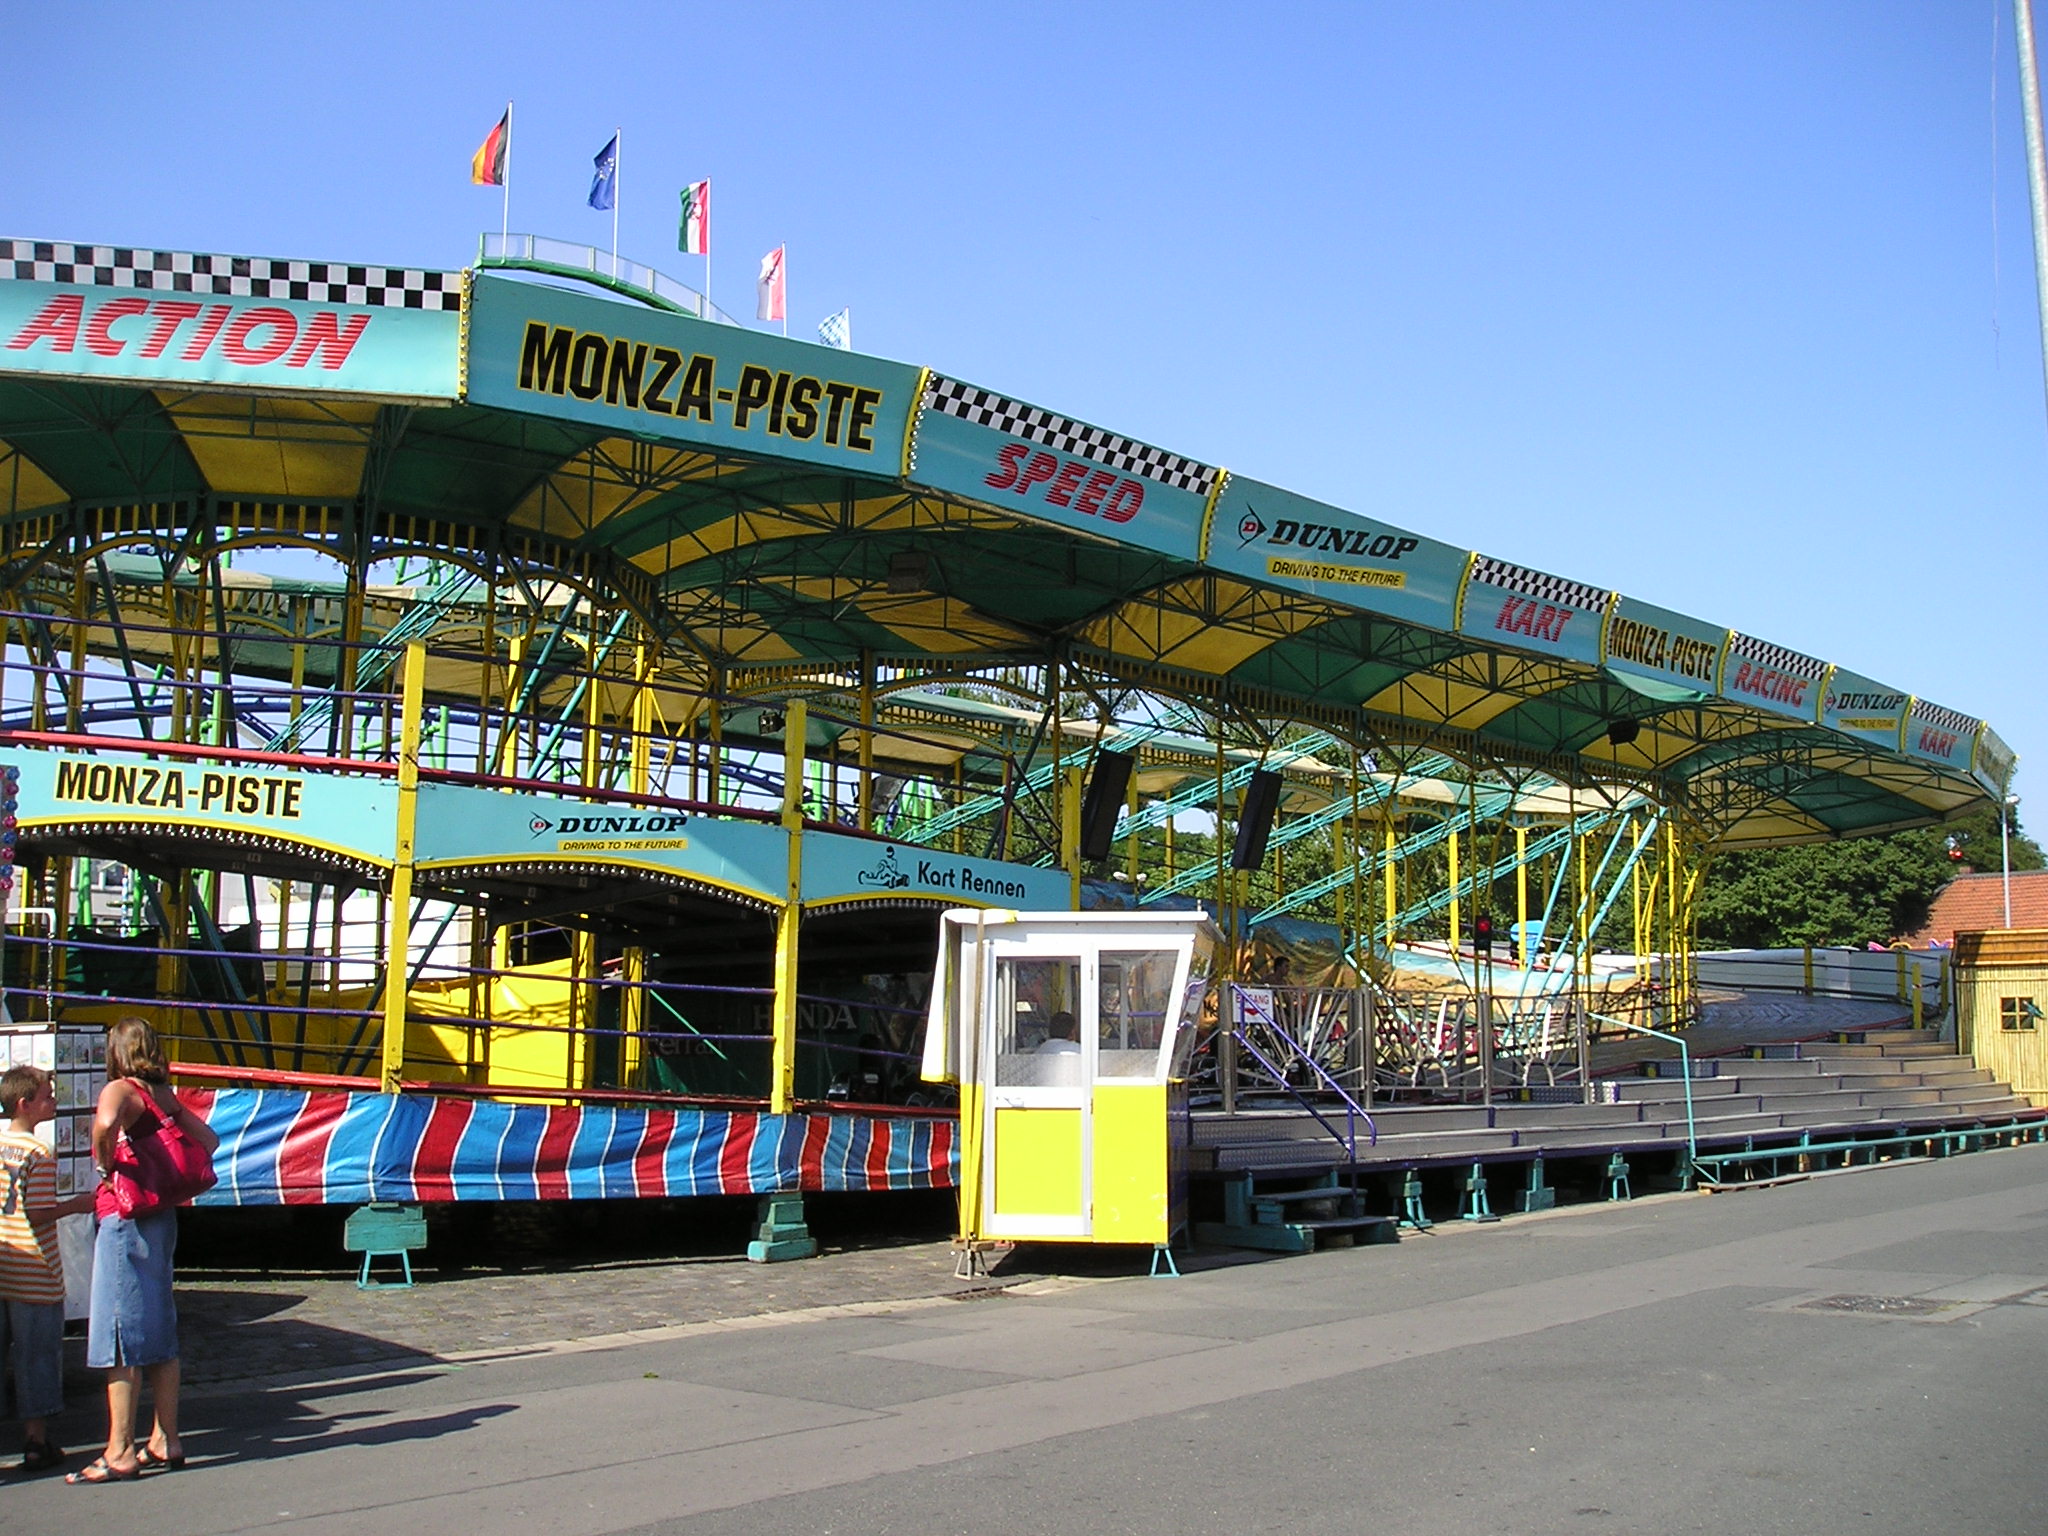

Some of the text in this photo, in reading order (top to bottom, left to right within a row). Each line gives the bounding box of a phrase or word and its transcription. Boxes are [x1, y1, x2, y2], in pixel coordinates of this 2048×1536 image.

[7, 294, 372, 371] ACTION
[517, 318, 883, 455] MONZA-PISTE
[983, 441, 1146, 525] SPEED
[1267, 519, 1419, 560] DUNLOP
[1272, 561, 1401, 586] DRIVING TO THE FUTURE
[1495, 595, 1574, 642] KART
[1608, 616, 1718, 682] MONZA-PISTE
[1733, 661, 1809, 708] RACING
[1837, 692, 1904, 710] DUNLOP
[1919, 725, 1958, 758] KART
[55, 759, 304, 819] MONZA-PISTE
[556, 816, 688, 834] DUNLOP
[563, 840, 683, 851] DRIVING TO THE FUTURE
[918, 861, 1026, 899] Kart Rennen
[752, 1003, 858, 1030] HNDA
